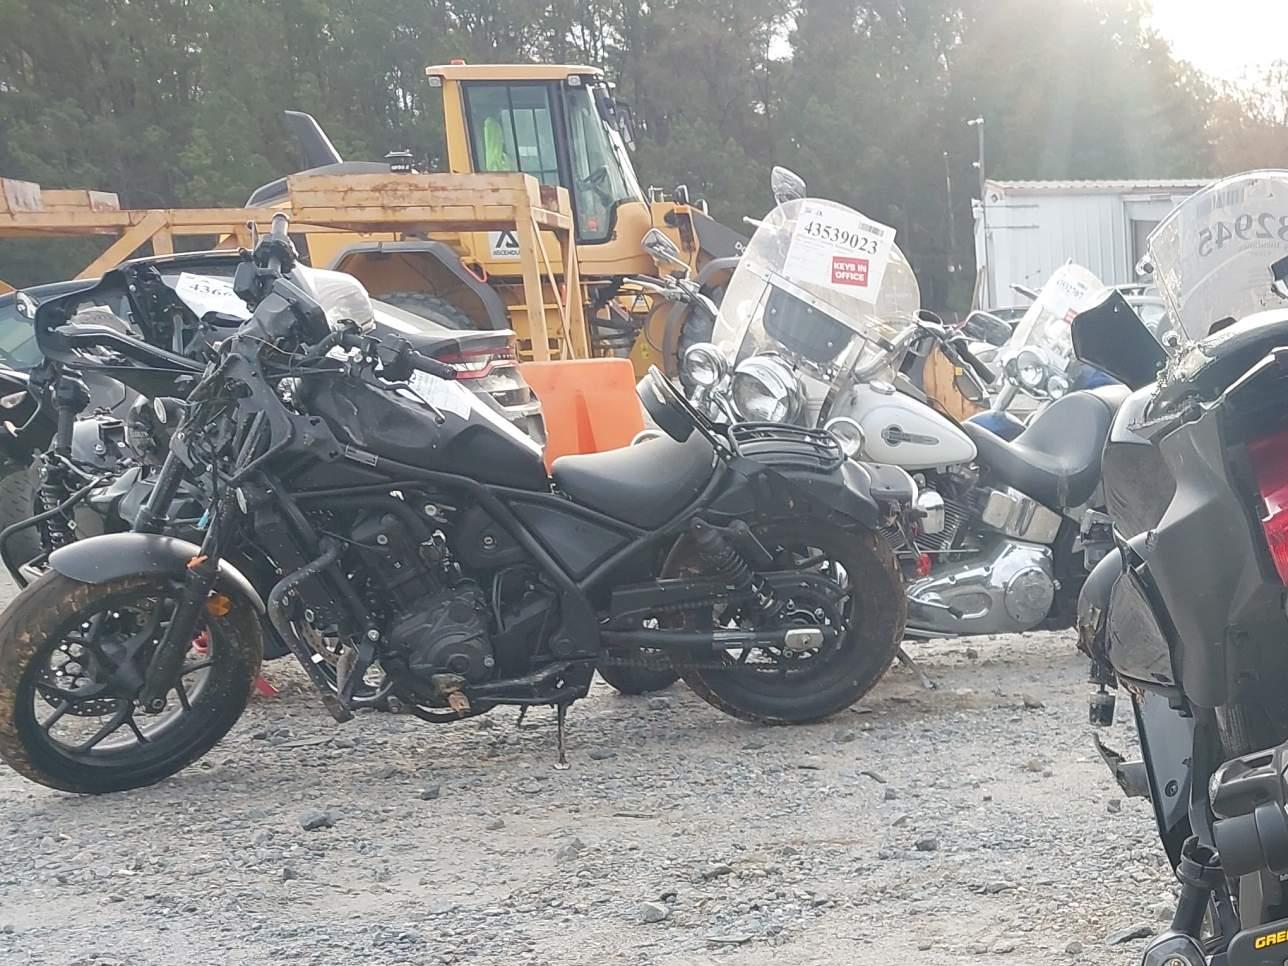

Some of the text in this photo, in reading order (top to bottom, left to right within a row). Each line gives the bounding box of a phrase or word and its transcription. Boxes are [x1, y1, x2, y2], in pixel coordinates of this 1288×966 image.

[804, 220, 878, 255] 43539023
[857, 263, 867, 273] IN
[835, 271, 865, 282] OFFICE
